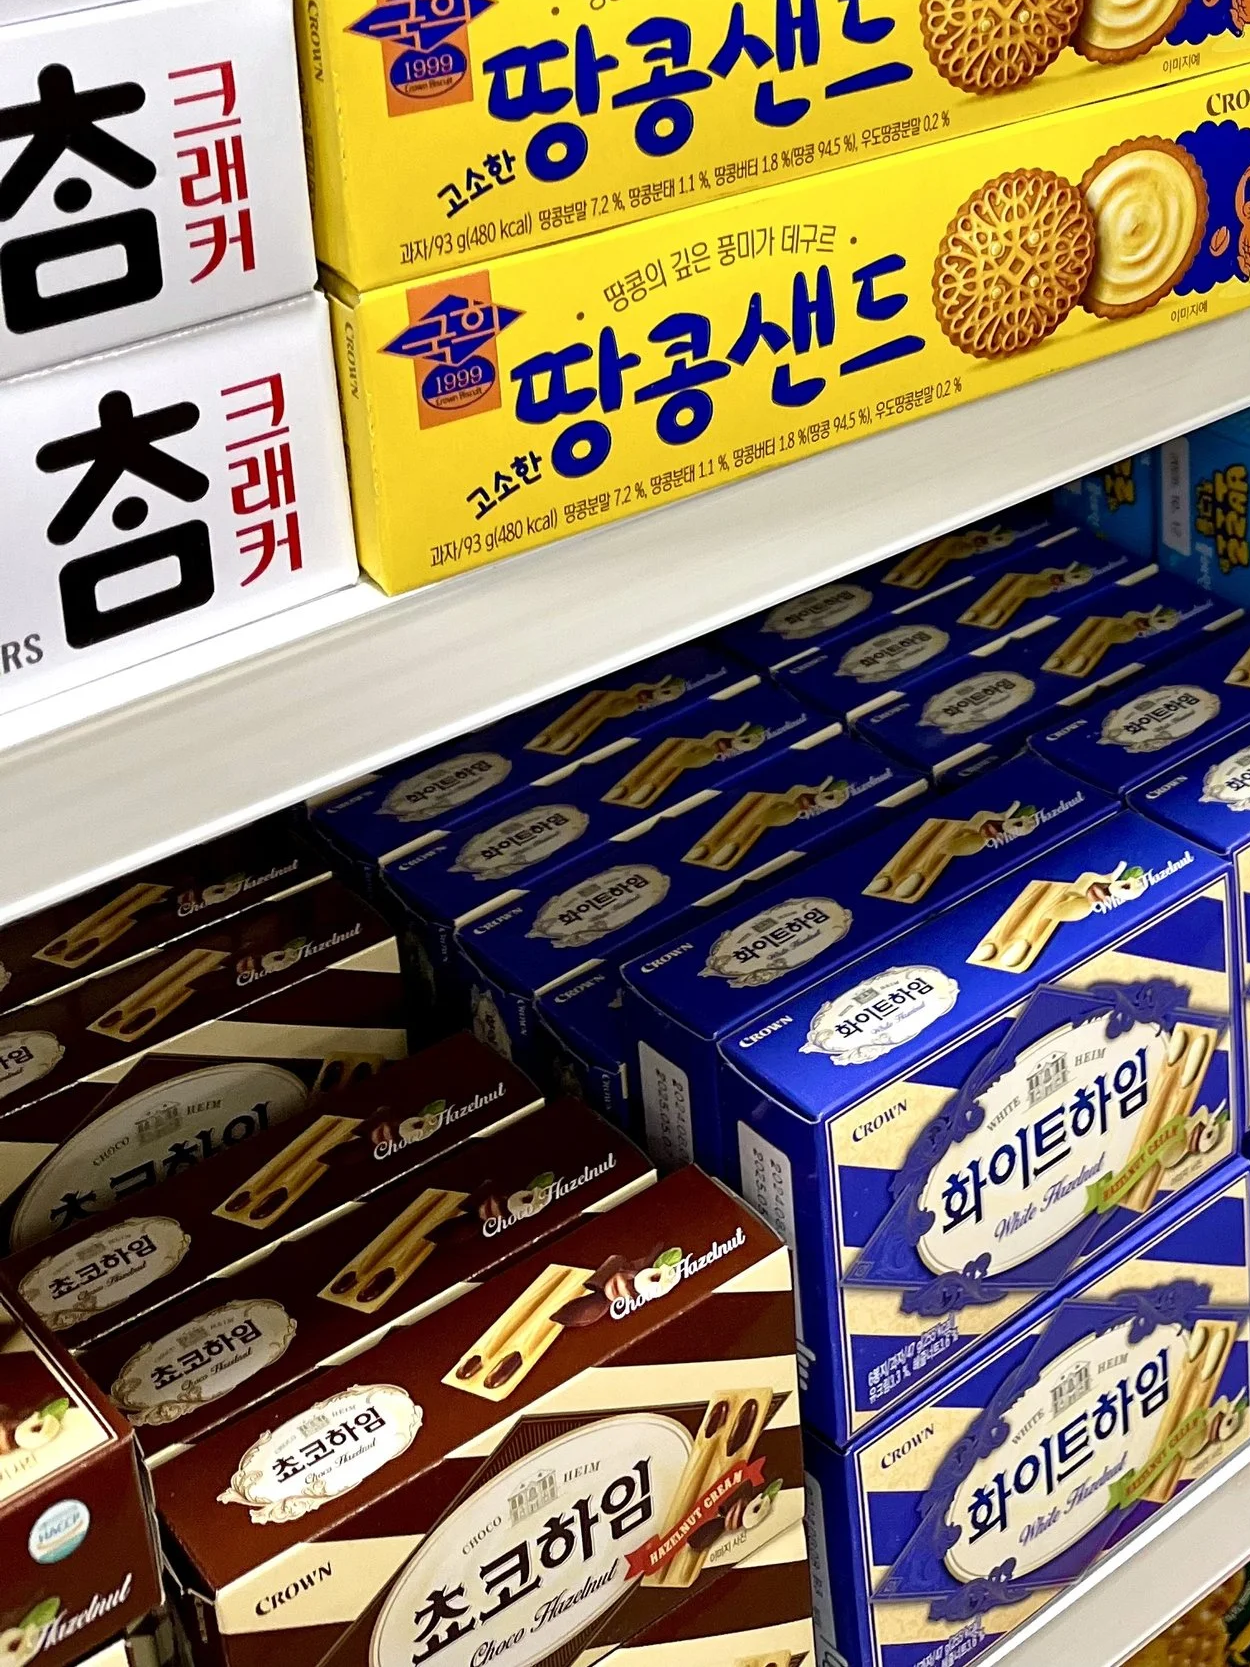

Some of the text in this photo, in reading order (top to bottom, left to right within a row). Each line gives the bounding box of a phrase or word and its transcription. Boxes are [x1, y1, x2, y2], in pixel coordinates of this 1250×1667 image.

[402, 51, 456, 81] 1999
[167, 59, 257, 285] 크래커
[436, 148, 517, 219] 고소한
[510, 253, 926, 479] 땅콩샌드
[220, 371, 304, 589] 크래커
[465, 451, 543, 521] 고소한
[731, 906, 831, 967] 화이트하임
[834, 977, 935, 1040] 화이트하임
[852, 1098, 908, 1144] CROWN
[986, 1047, 1106, 1133] WHITE HEIM
[941, 1046, 1149, 1235] 화이트하임
[993, 1151, 1107, 1244] White Hazelnut
[150, 1318, 262, 1392] 초코하임
[271, 1405, 389, 1485] 초코하임
[880, 1423, 936, 1471] CROWN
[967, 1346, 1171, 1546] 화이트하임
[462, 1460, 601, 1557] CHOCO HEIM
[649, 1505, 703, 1566] HAZELNUT
[254, 1560, 334, 1618] CROWN
[411, 1455, 655, 1666] 초코하임
[470, 1557, 619, 1667] Choco Hazelnut
